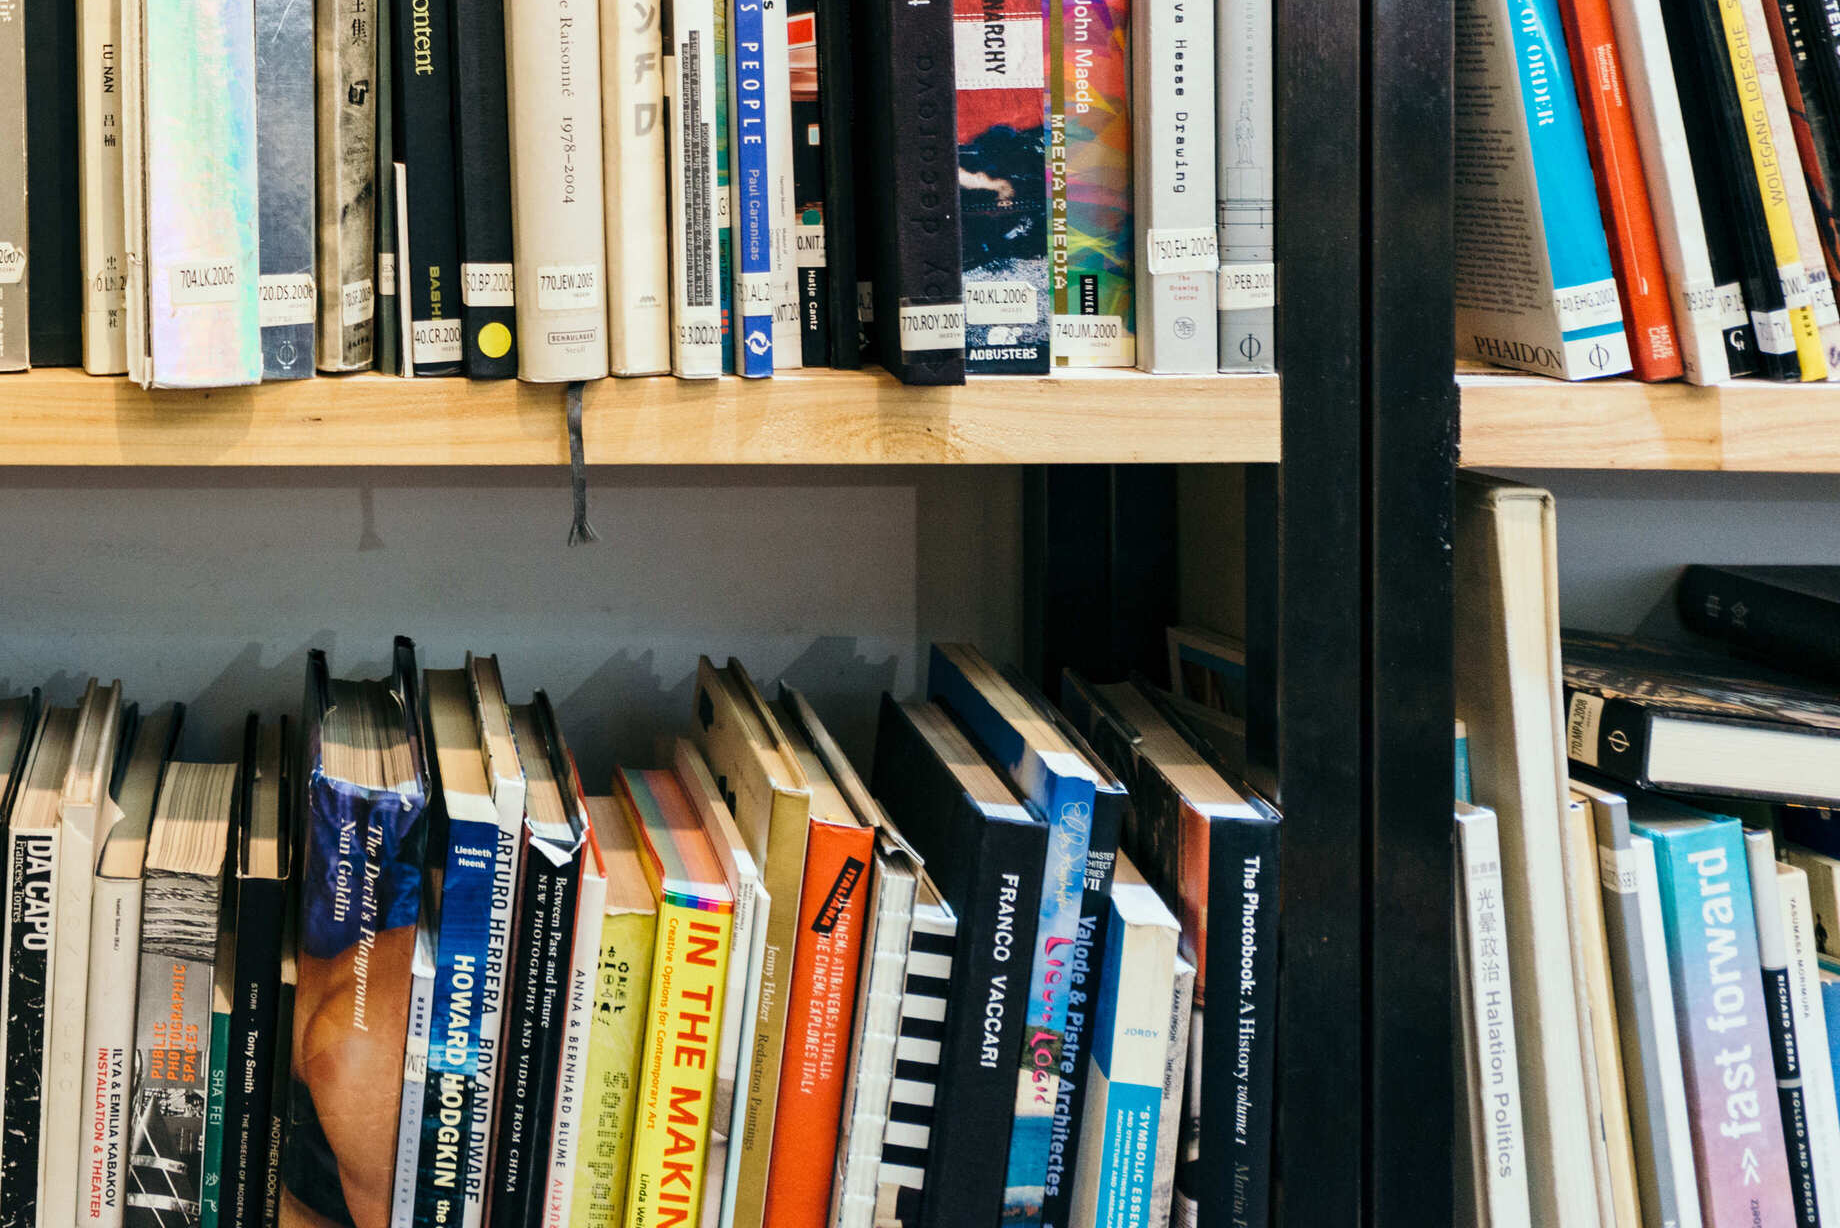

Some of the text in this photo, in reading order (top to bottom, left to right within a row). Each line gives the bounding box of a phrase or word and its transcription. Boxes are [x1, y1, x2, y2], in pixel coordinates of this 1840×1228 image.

[557, 15, 579, 100] Raisonné
[1517, 8, 1540, 39] OF
[741, 41, 759, 146] PEOPLE
[1074, 48, 1093, 114] Maeda
[1173, 39, 1189, 98] Hesse
[1524, 44, 1556, 127] ORDER
[1171, 111, 1190, 195] Drawing
[965, 288, 1029, 305] 740.KL.2006
[969, 348, 1039, 361] ADBUSTERS
[332, 818, 356, 923] Nan Goldin
[363, 824, 384, 860] The
[1242, 856, 1260, 890] The
[21, 838, 53, 951] DA CAPO
[351, 925, 376, 1032] Playground
[685, 920, 722, 969] IN
[980, 872, 1019, 1069] FRANCO VACCARI
[1239, 891, 1259, 997] Photobook:
[674, 983, 714, 1071] THE
[1239, 1000, 1255, 1015] A
[1687, 848, 1763, 1138] fast forward
[433, 954, 476, 1188] HOWARD HODGKIN
[1233, 1017, 1255, 1082] History
[1483, 989, 1515, 1180] Halation Politics
[88, 1047, 109, 1219] INSTALLATION & THEATER
[104, 1047, 124, 1208] ILYA & EMILIA KABAKOV
[1234, 1084, 1251, 1134] volume
